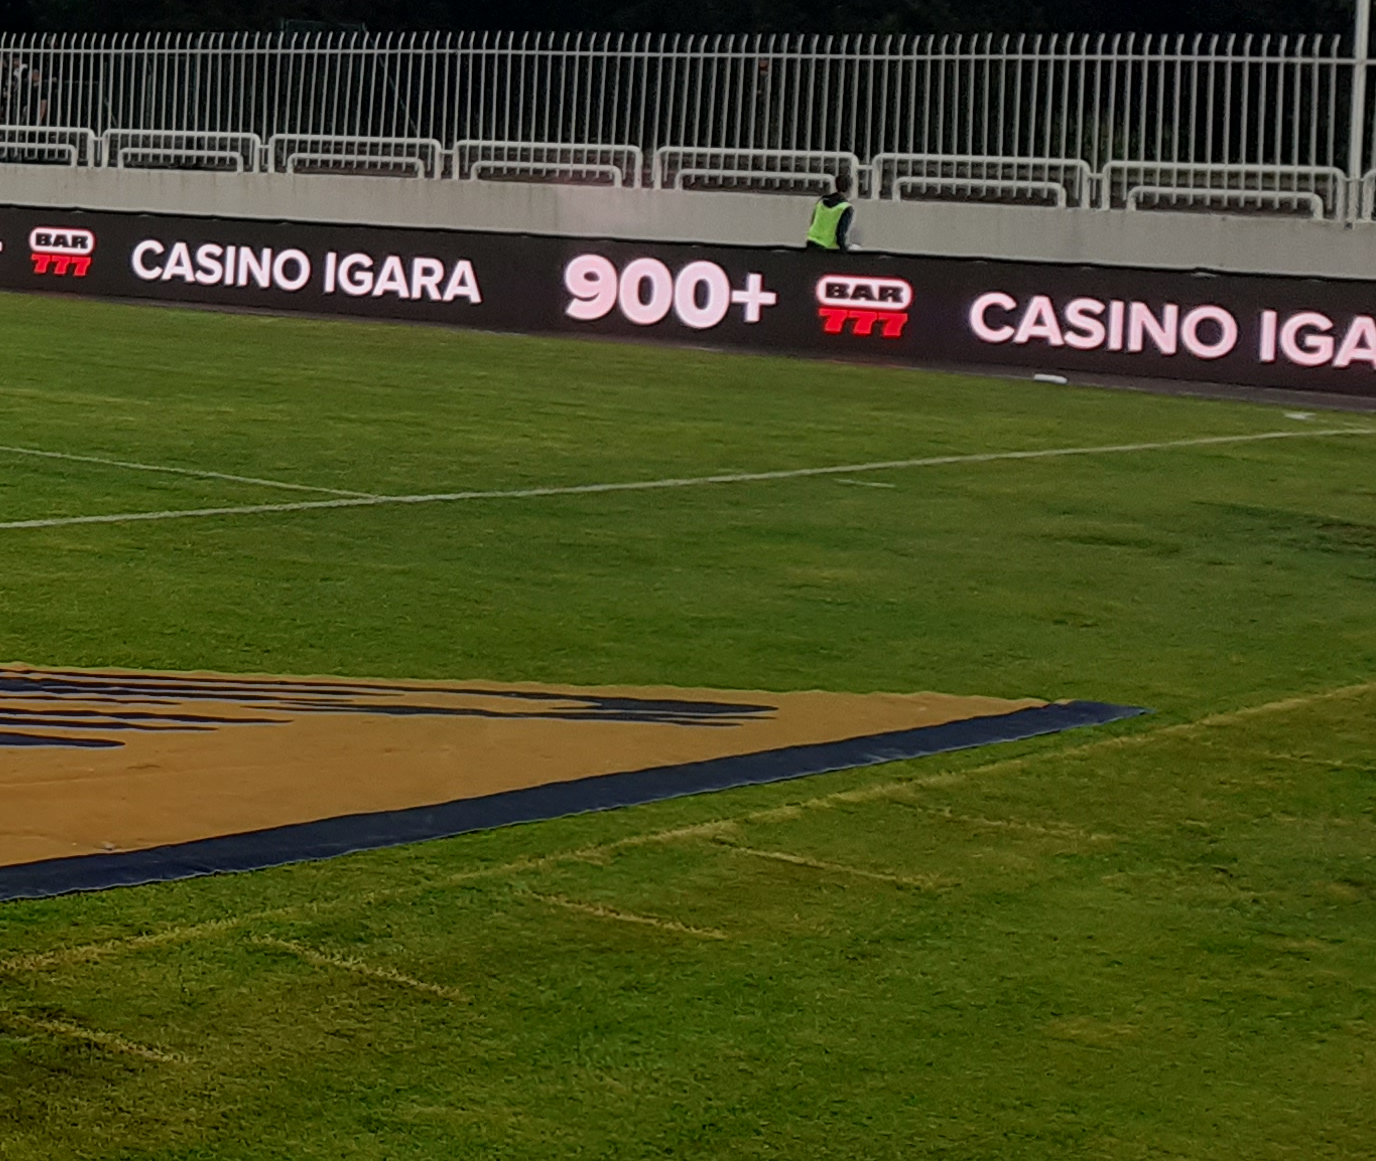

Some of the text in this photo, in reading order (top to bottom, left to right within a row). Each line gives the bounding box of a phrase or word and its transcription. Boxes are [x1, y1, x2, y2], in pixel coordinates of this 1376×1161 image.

[35, 232, 89, 249] BAR
[31, 253, 92, 276] 777
[131, 239, 481, 303] CASINO IGARA
[564, 254, 776, 328] 900+
[825, 282, 904, 304] BAR
[818, 307, 909, 337] 777
[969, 292, 1237, 358] CASINO
